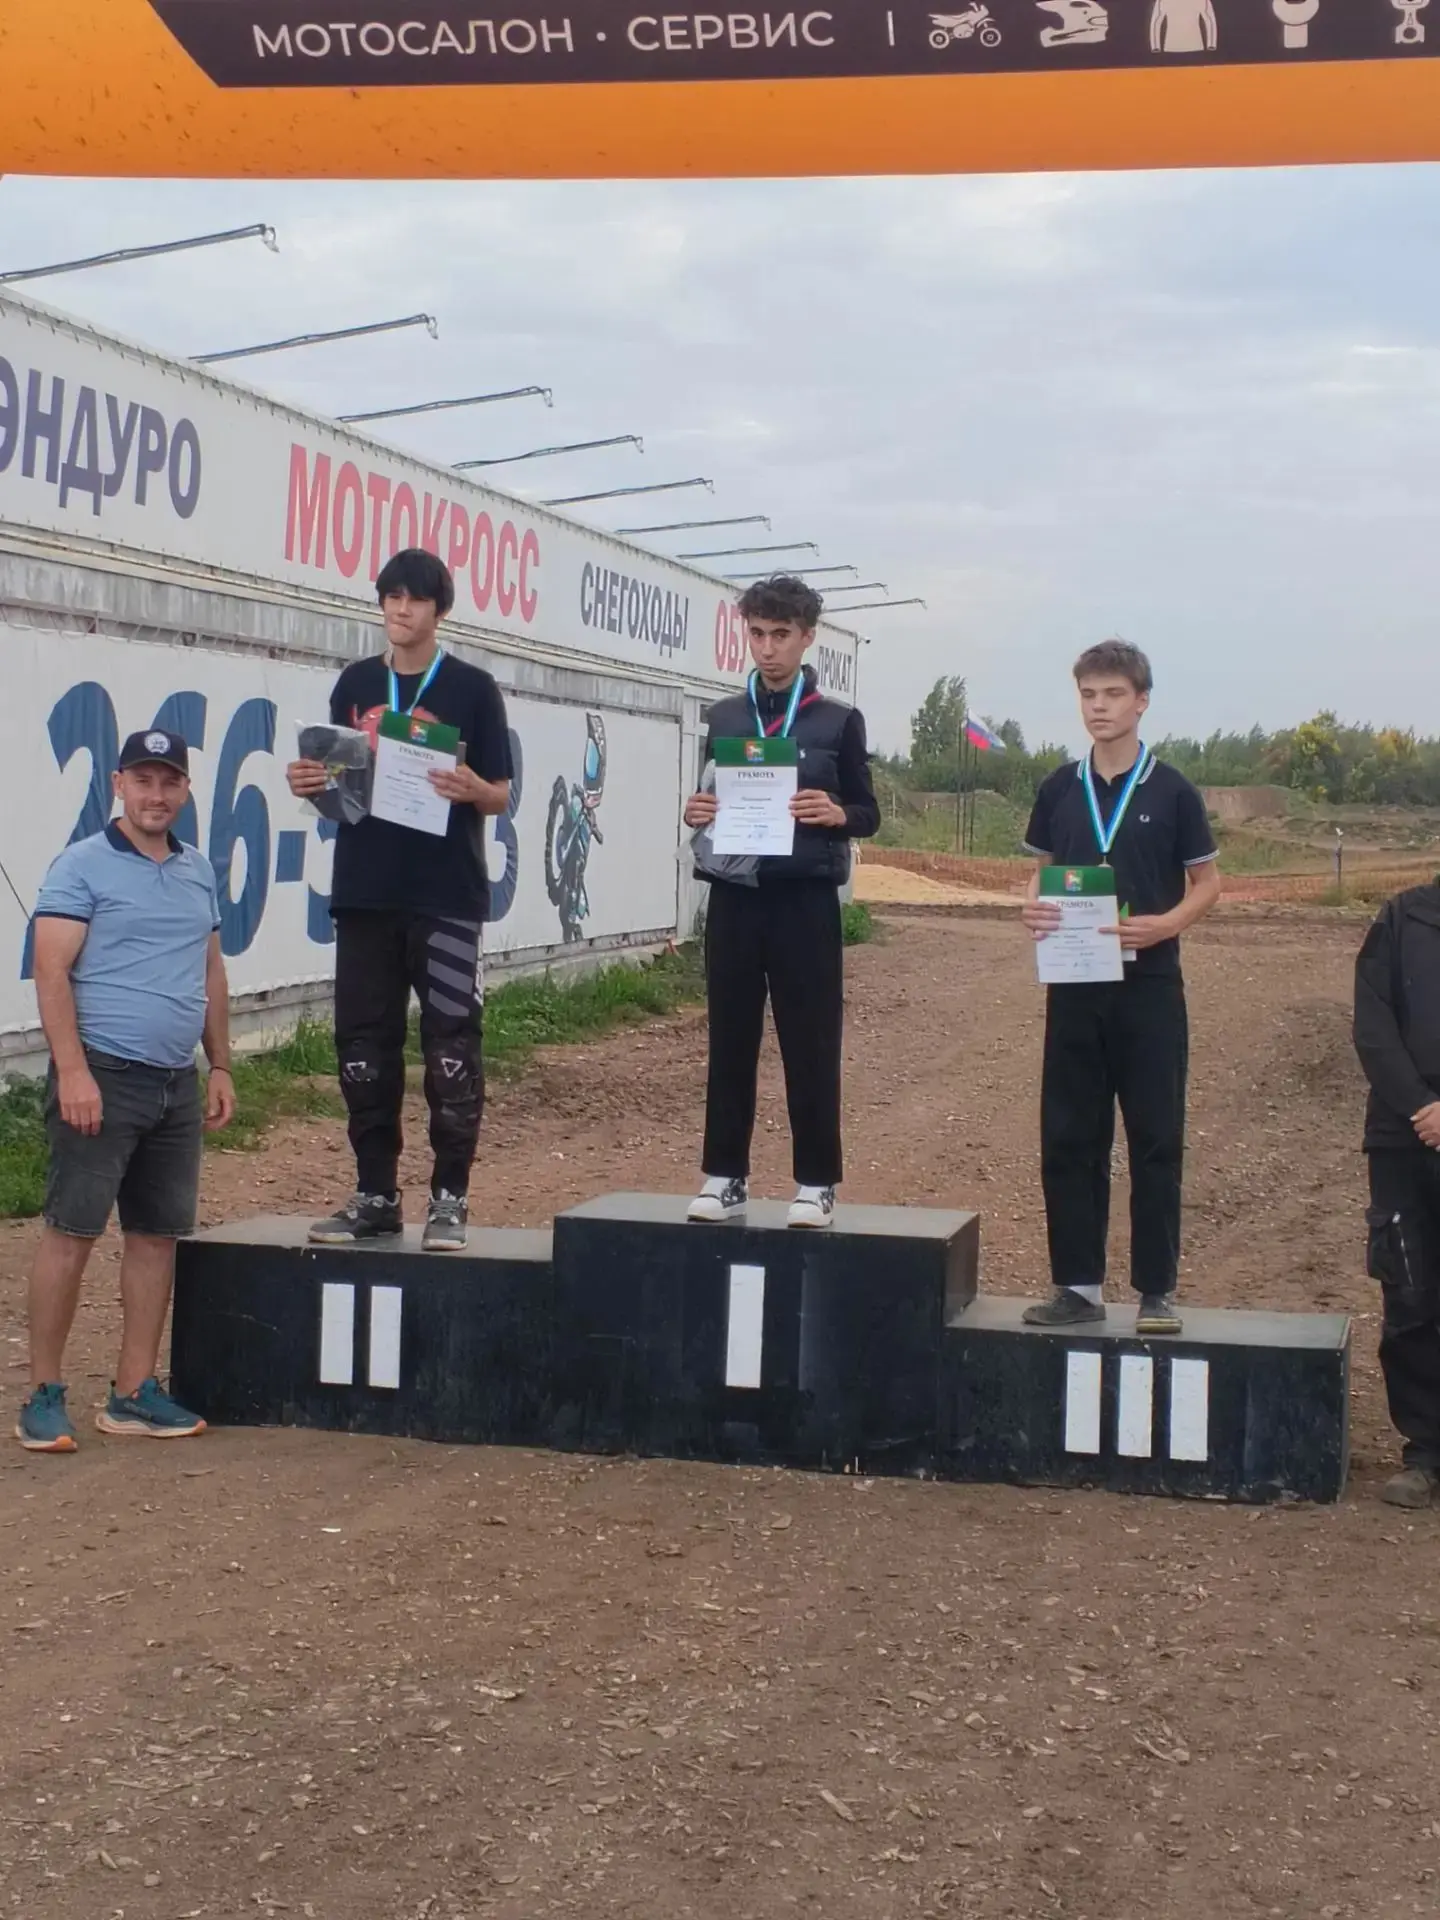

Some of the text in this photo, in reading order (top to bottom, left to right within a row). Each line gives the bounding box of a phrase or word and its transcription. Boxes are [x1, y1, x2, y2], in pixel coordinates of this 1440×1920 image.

[252, 11, 834, 57] МОТОСАЛОН СЕРВИС
[285, 443, 540, 623] МОТОКРОСС
[580, 561, 689, 658] СНЕГОХОДЫ
[818, 645, 852, 693] ПРОКАТ
